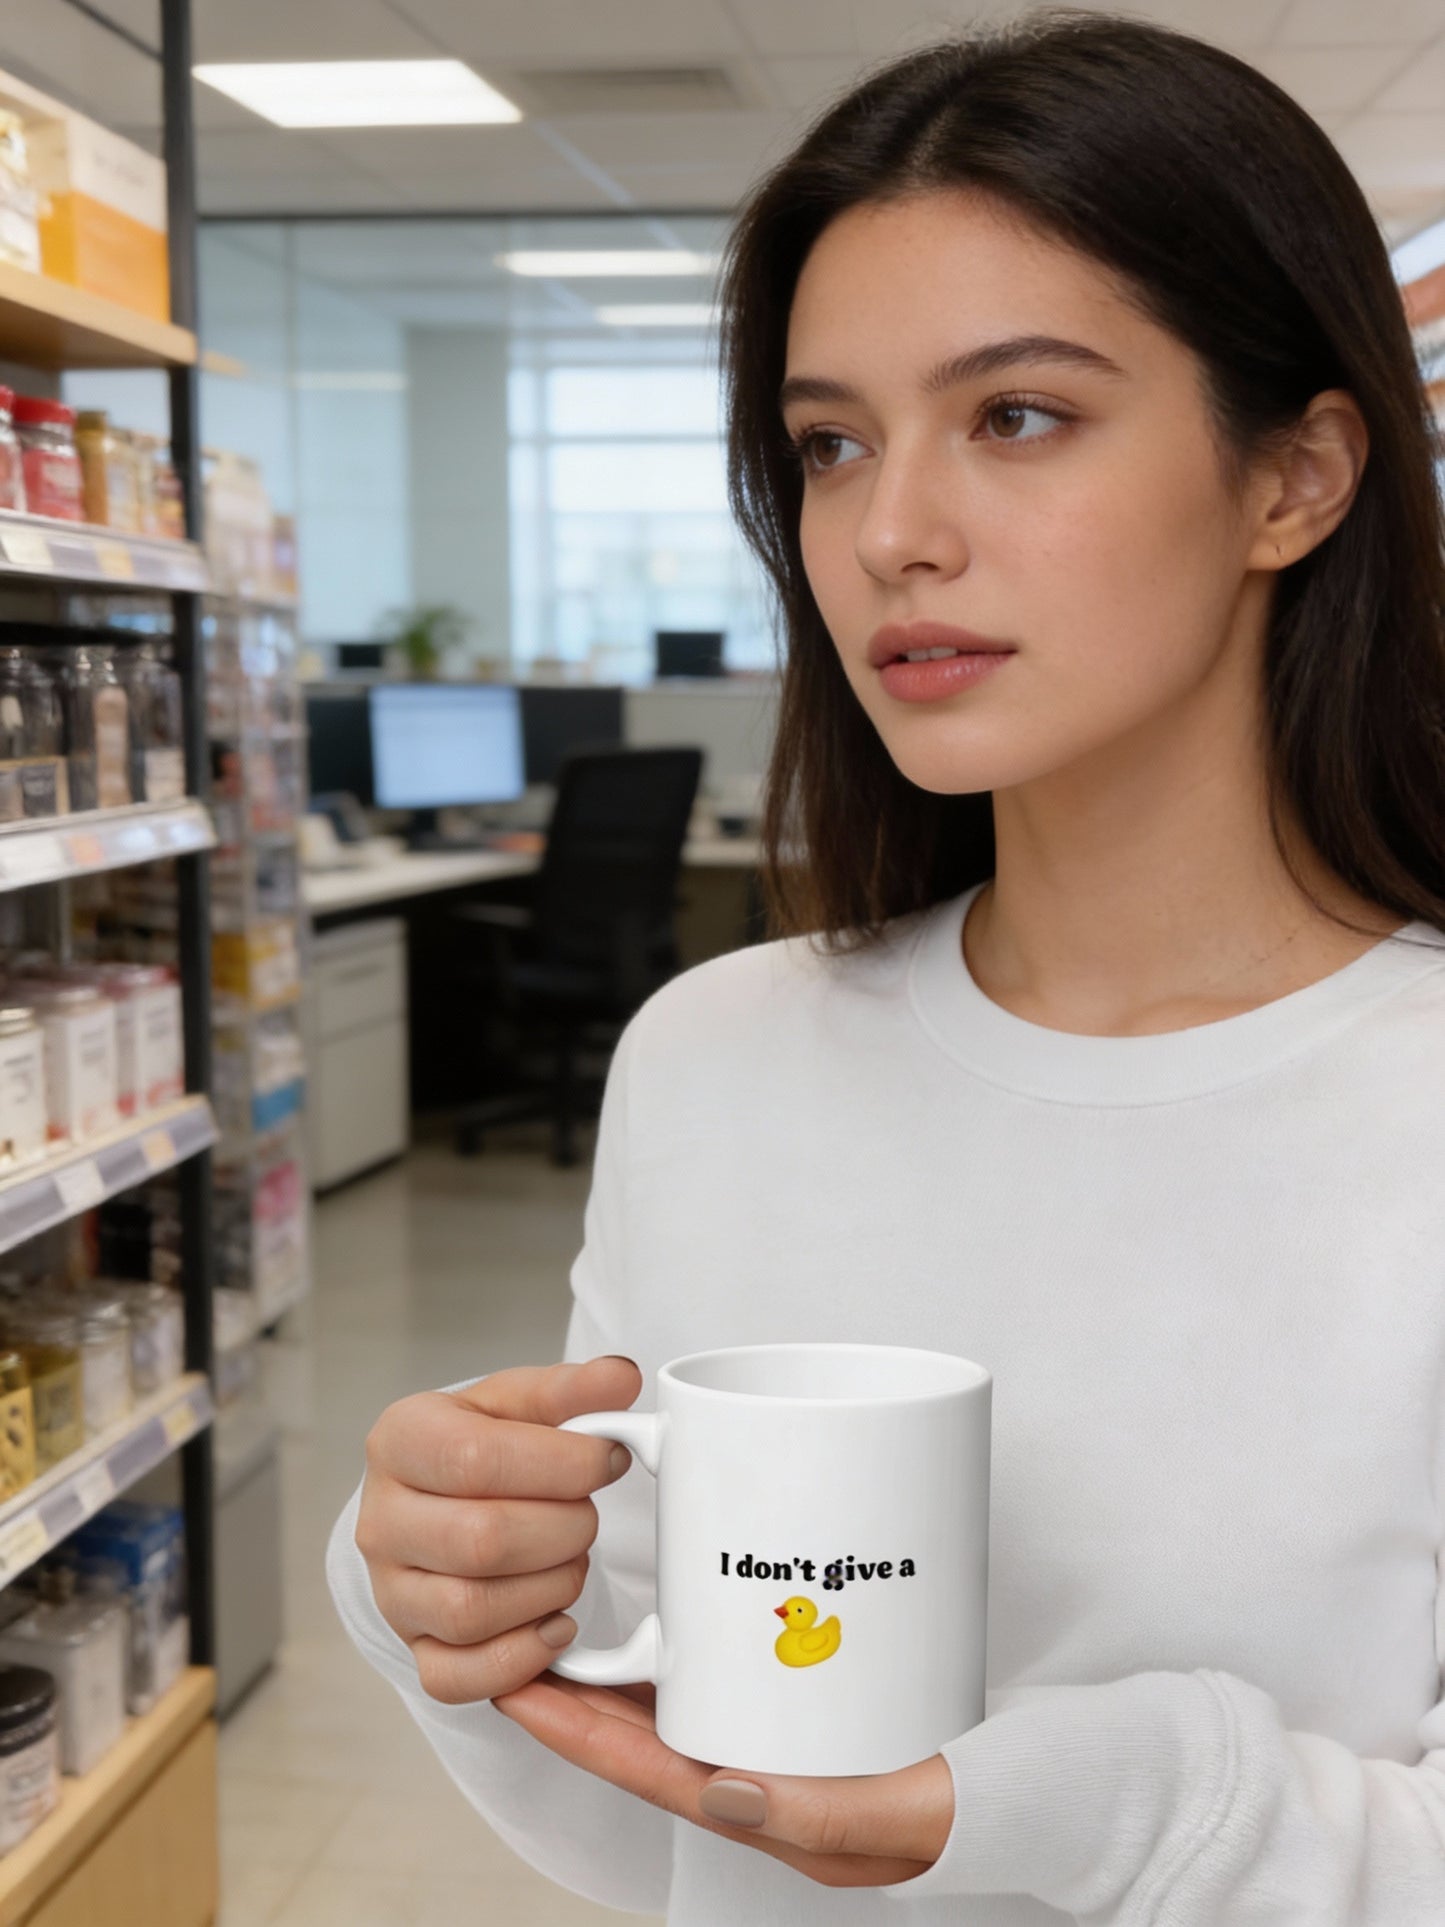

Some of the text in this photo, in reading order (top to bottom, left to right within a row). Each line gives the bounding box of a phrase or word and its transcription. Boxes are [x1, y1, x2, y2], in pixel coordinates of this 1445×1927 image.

[721, 1552, 916, 1591] I don't give a
